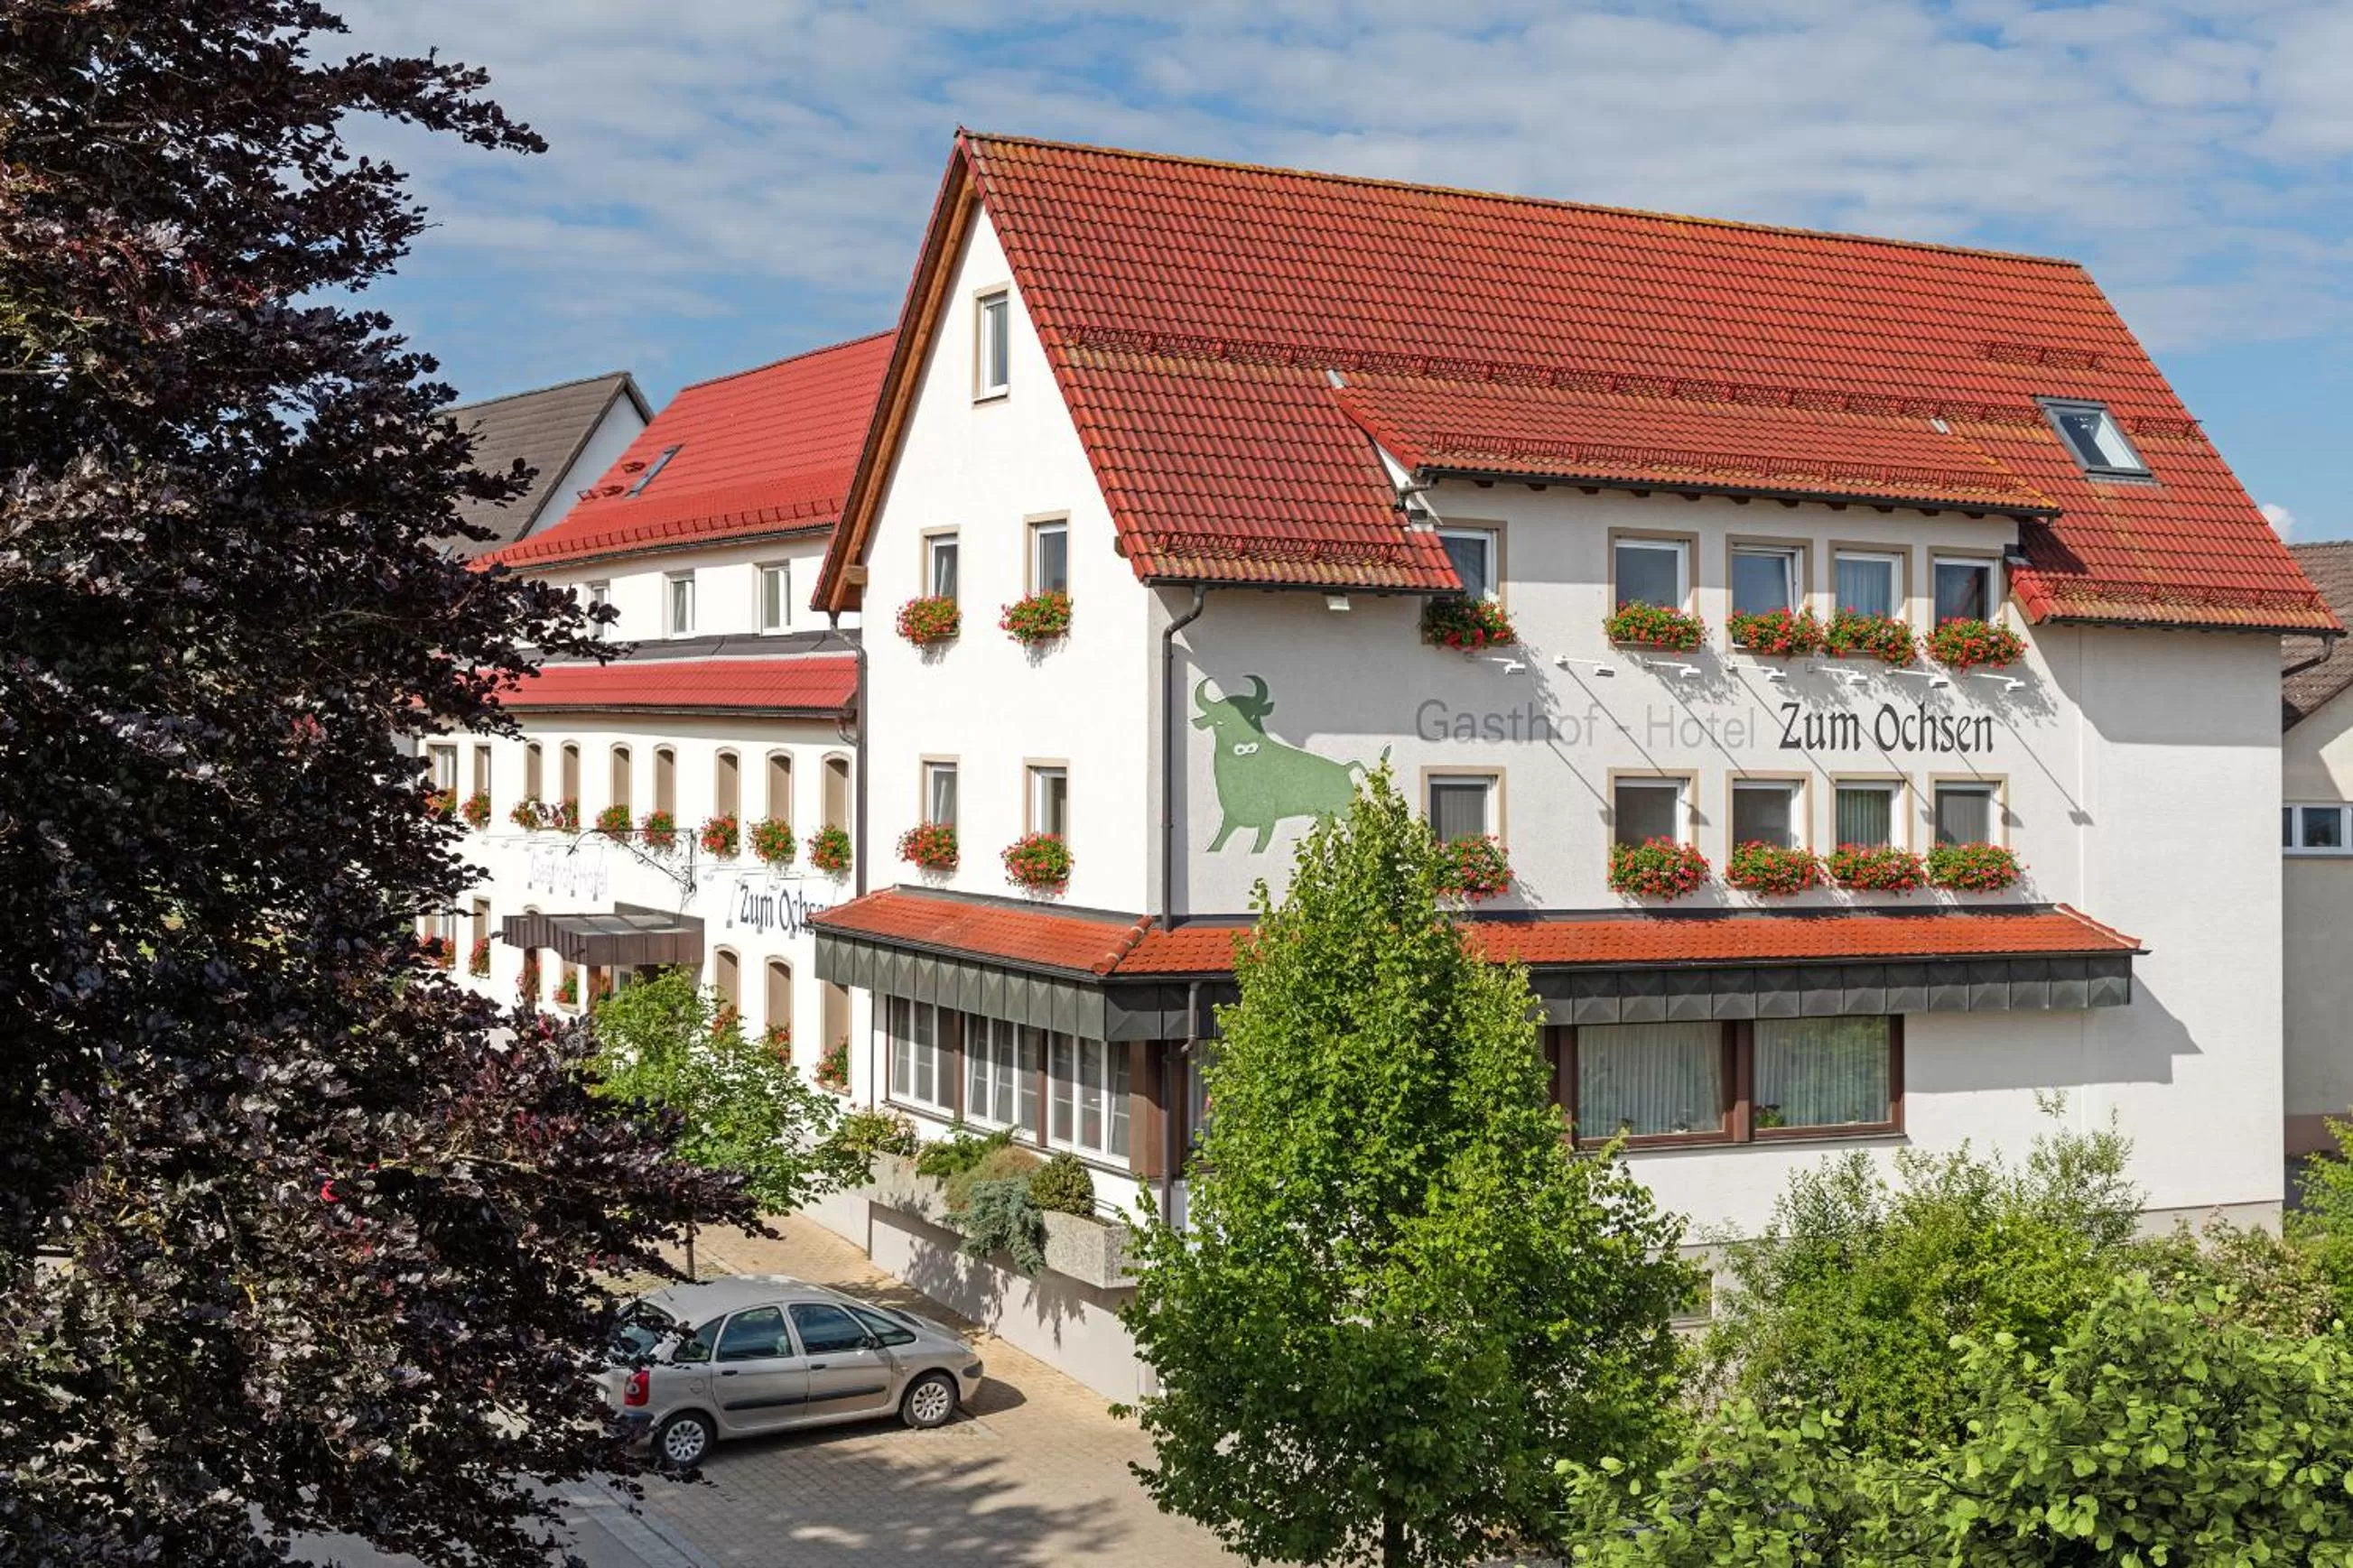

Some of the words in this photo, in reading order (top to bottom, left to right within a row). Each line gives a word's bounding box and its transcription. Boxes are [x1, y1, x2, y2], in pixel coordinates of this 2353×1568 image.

[1416, 699, 1599, 746] Gasthof
[1646, 704, 1754, 748] Hotel
[1779, 701, 1861, 751] Zum
[1874, 700, 1994, 753] Ochsen
[740, 885, 774, 928] Zum
